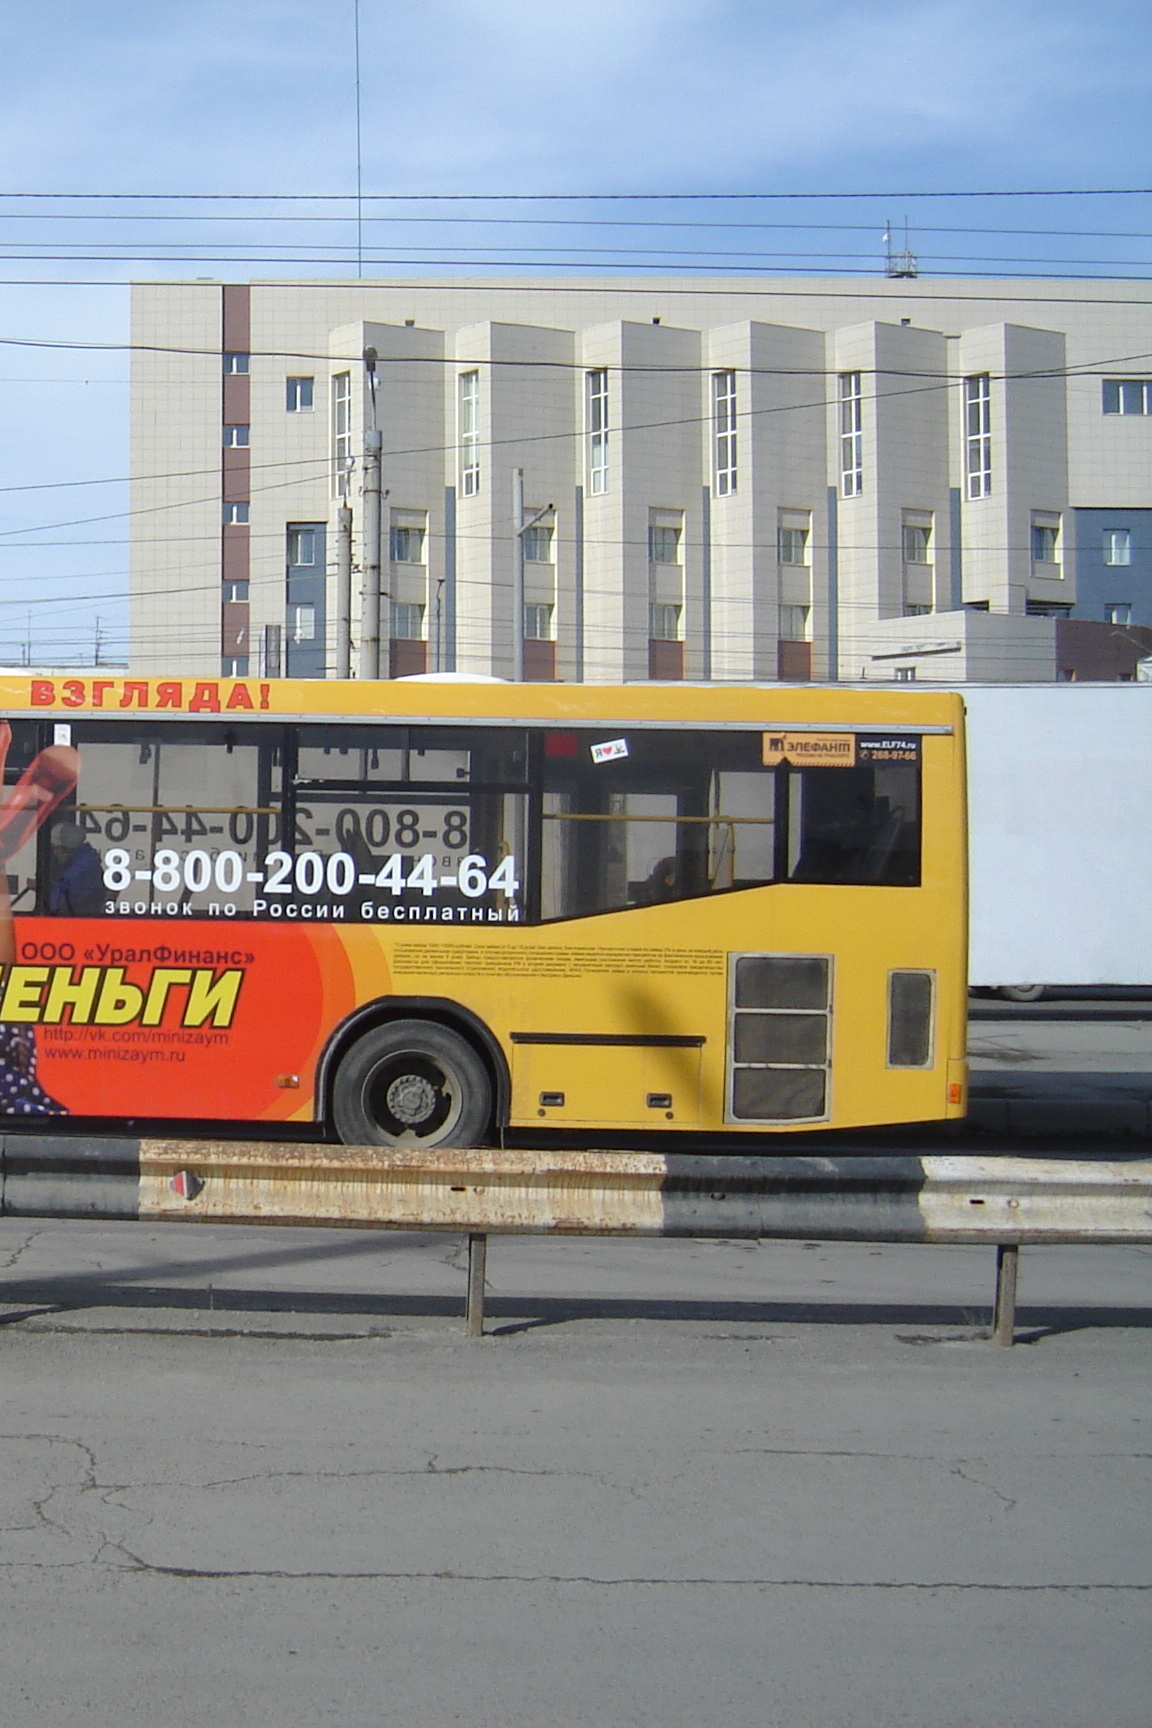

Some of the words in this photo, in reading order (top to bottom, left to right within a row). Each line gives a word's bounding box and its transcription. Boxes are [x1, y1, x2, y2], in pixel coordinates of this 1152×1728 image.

[30, 680, 271, 713] ВЗГЛЯДА!
[102, 848, 520, 899] 8-800-200-44-64
[104, 901, 194, 916] звонок
[208, 902, 237, 917] по
[252, 899, 346, 919] России
[360, 901, 521, 922] бесплатный
[21, 942, 76, 961] ООО
[83, 943, 256, 966] «УралФинанс»
[43, 1026, 229, 1047] http://vk.com/minizaym
[44, 1047, 186, 1064] www.minizaym.ru
